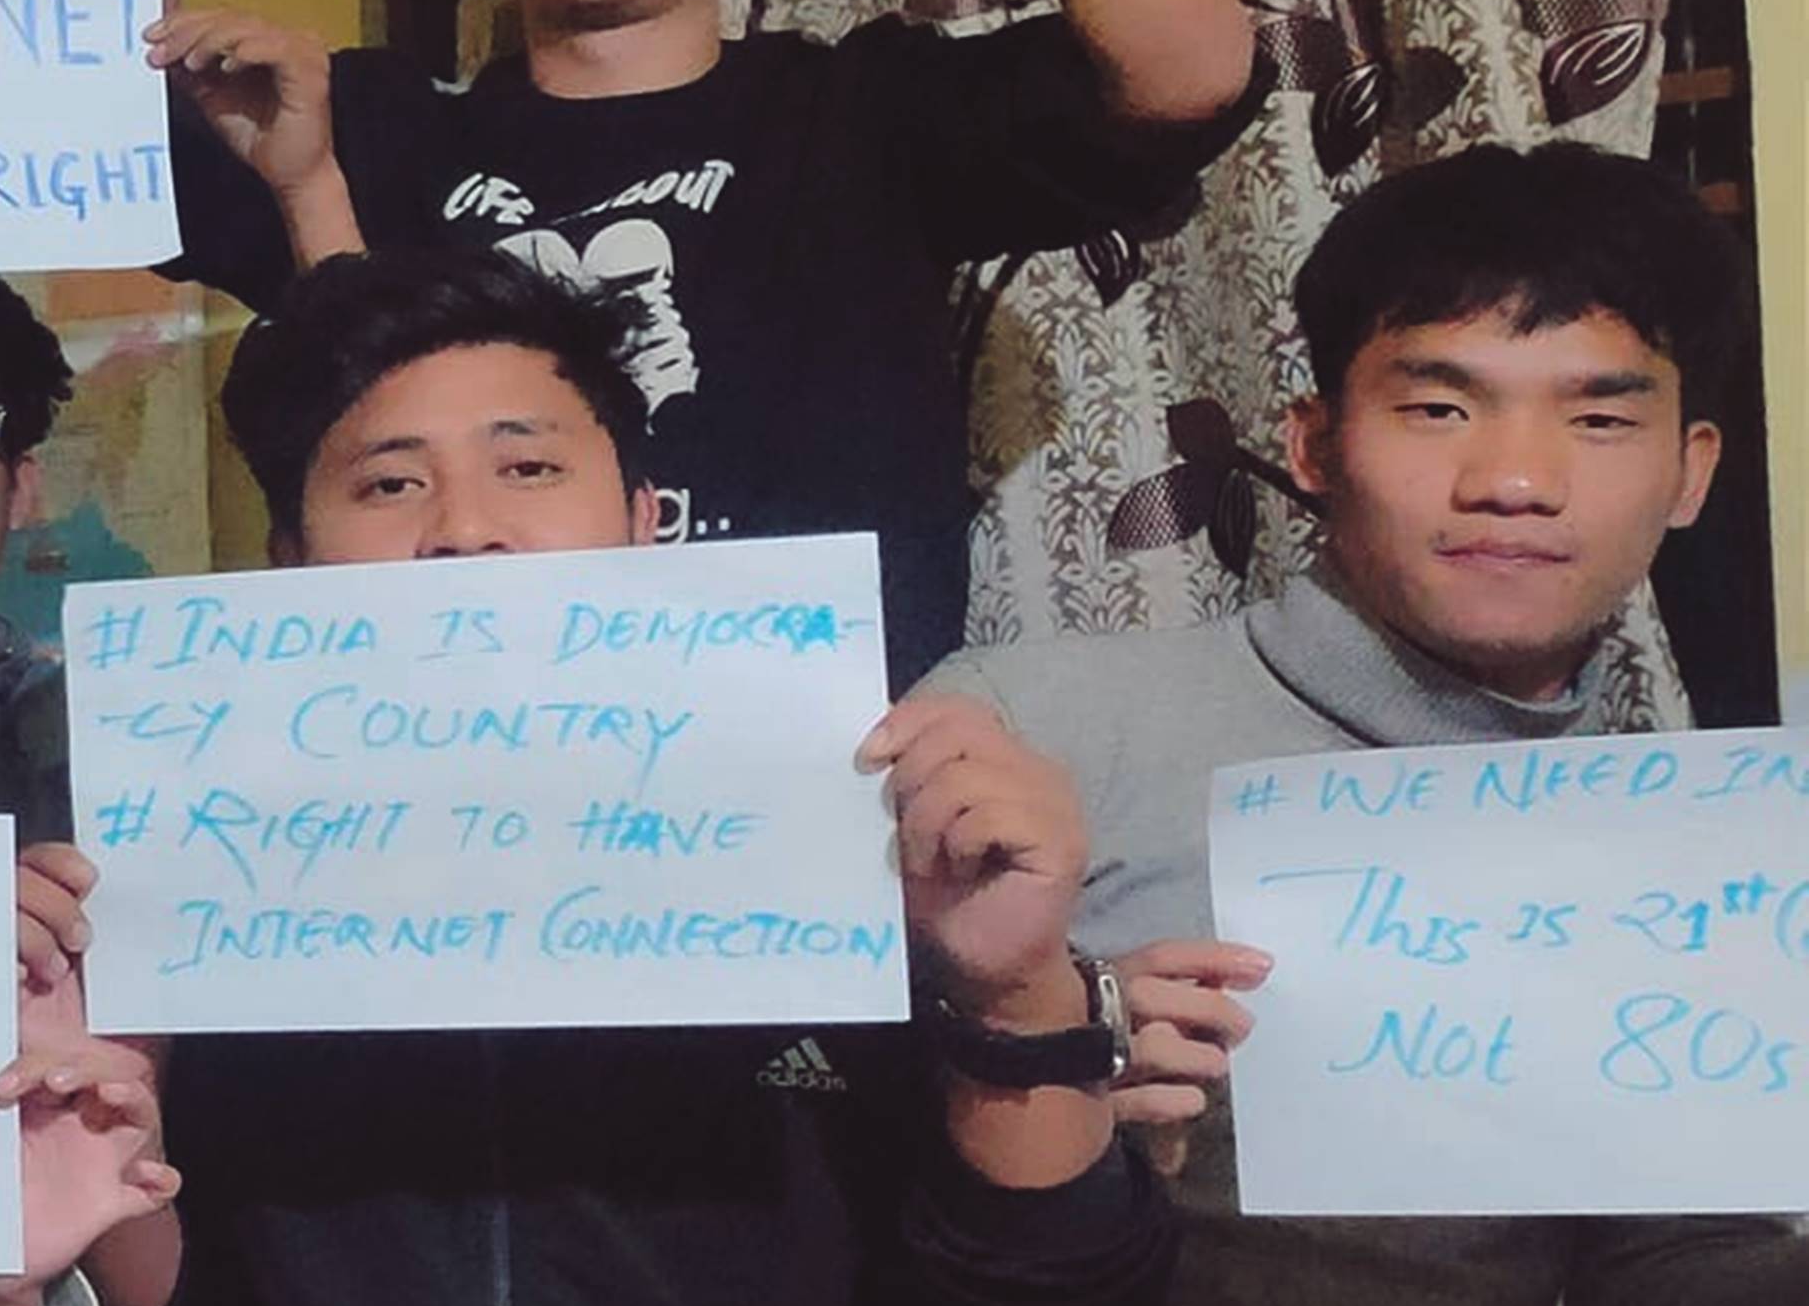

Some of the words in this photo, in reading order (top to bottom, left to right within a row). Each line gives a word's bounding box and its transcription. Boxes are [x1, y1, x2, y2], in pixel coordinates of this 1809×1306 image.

[416, 610, 505, 662] IS
[290, 683, 694, 797] COUNTRY
[1320, 762, 1444, 816] WE
[1472, 749, 1678, 814] NEED
[184, 787, 411, 891] RIGHT
[451, 807, 530, 851] TO
[571, 798, 771, 855] HAVE
[157, 899, 516, 976] INTERNET
[538, 886, 895, 970] CONNECTION
